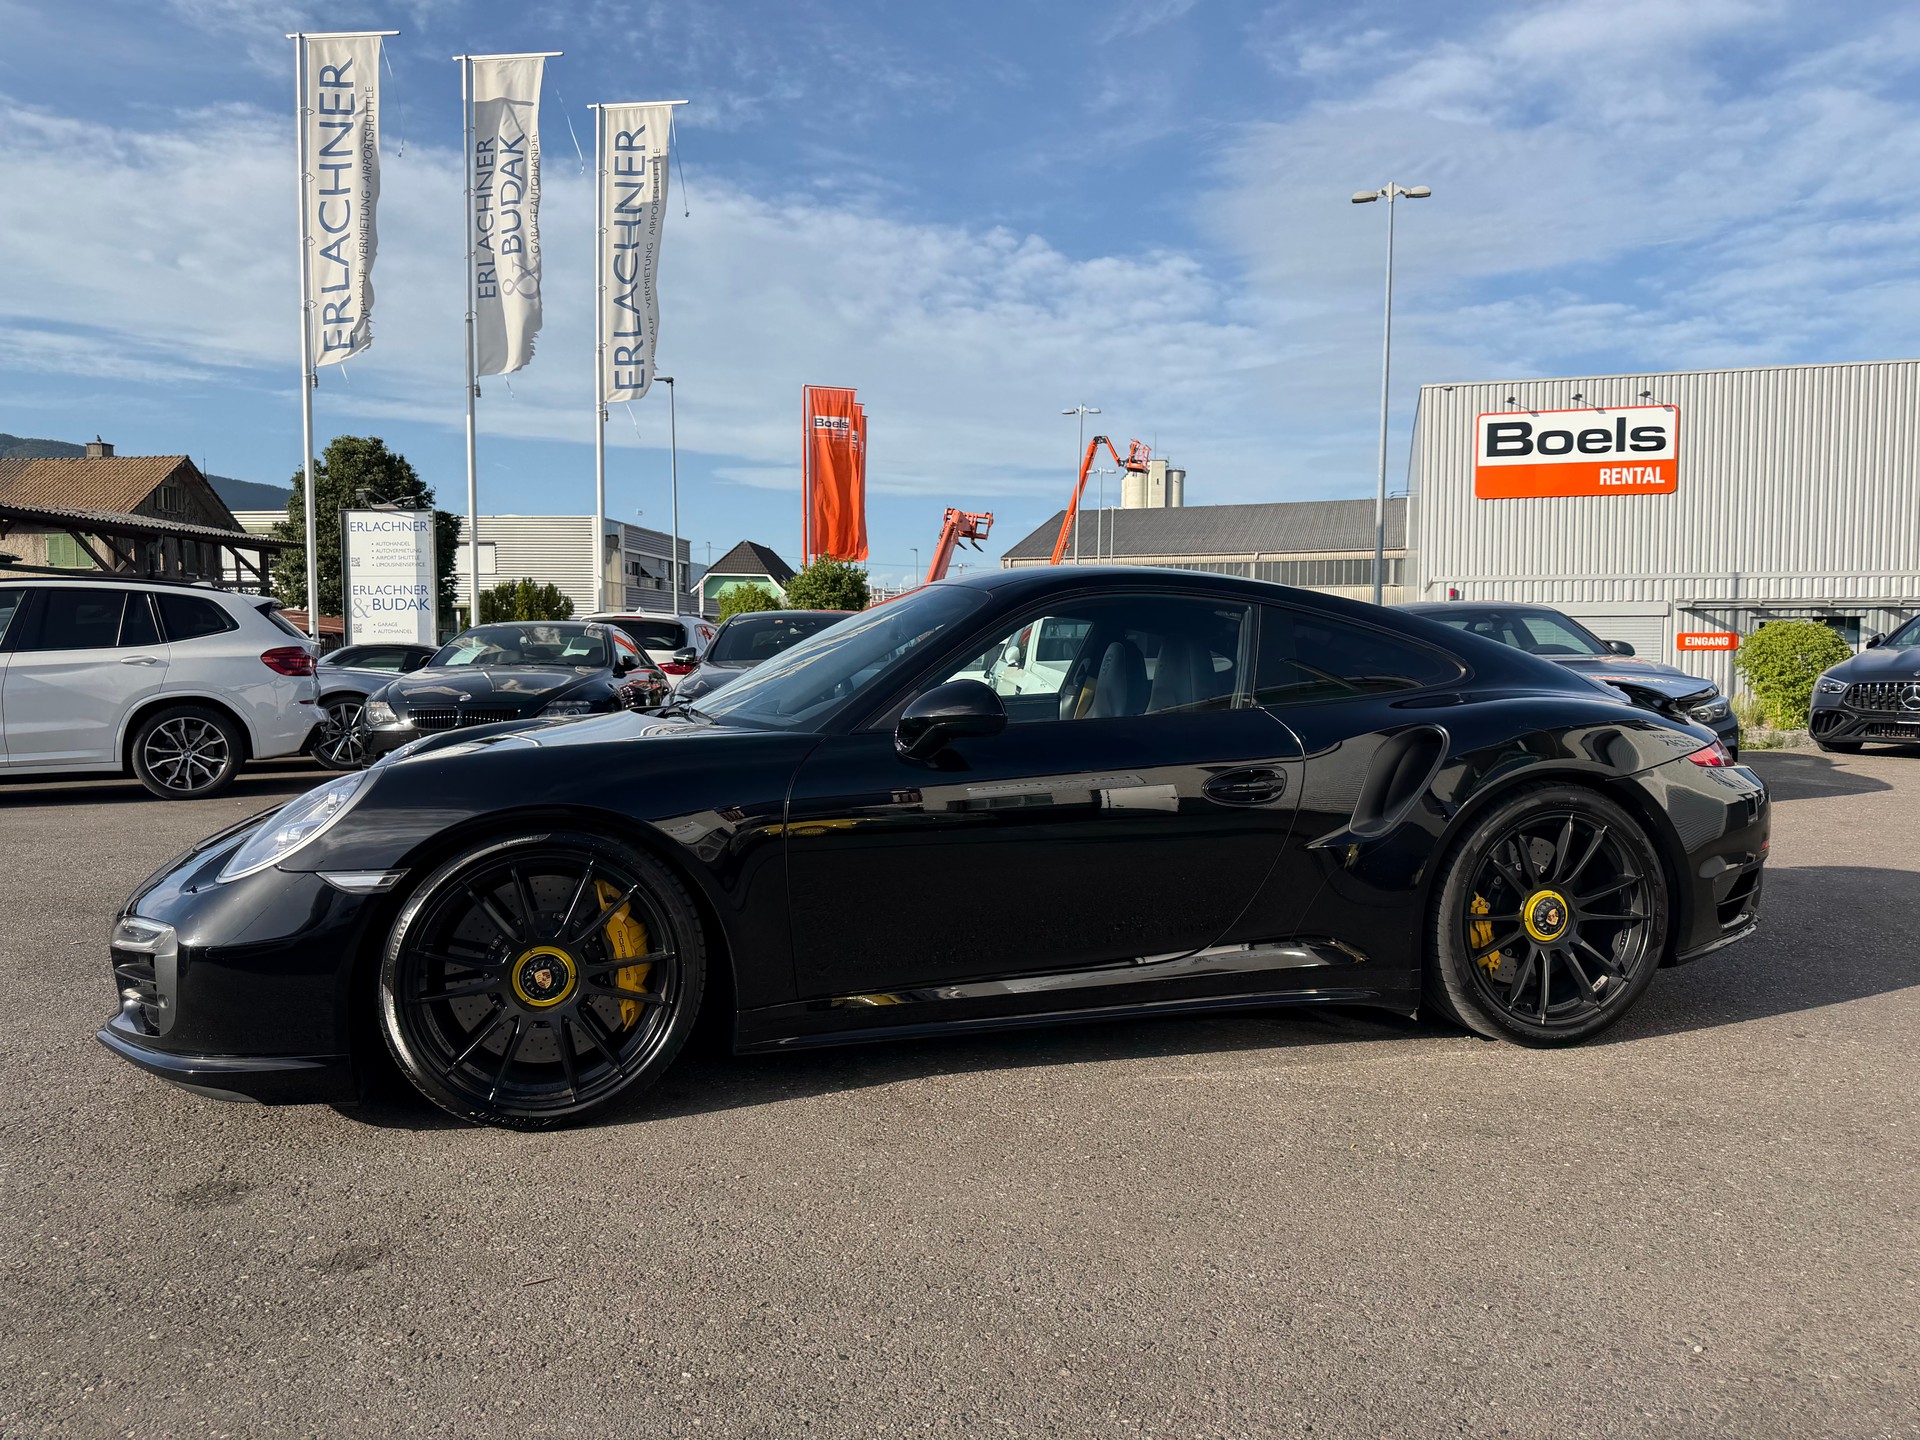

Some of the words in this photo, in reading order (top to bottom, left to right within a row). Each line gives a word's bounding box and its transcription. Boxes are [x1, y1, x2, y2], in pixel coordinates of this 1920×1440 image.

[362, 86, 375, 184] AIRPORTSHUTTLE
[318, 57, 355, 352] ERLACHNER
[476, 136, 496, 299] ERLACHNER
[500, 133, 526, 256] BUDAK
[648, 148, 661, 236] AIRPORTSHUTTLE
[359, 190, 371, 261] VERMIETUNG
[502, 256, 541, 301] &
[613, 124, 646, 391] ERLACHNER
[643, 242, 654, 309] VERMIETUNG
[814, 417, 849, 429] Boels
[1486, 417, 1667, 458] Boels
[1600, 466, 1665, 486] RENTAL
[350, 521, 428, 532] ERLACHNER
[352, 597, 371, 618] &
[372, 598, 430, 611] BUDAK
[353, 585, 429, 595] ERLACHNER
[1685, 635, 1729, 647] EINGANG
[618, 930, 631, 981] PORSHE
